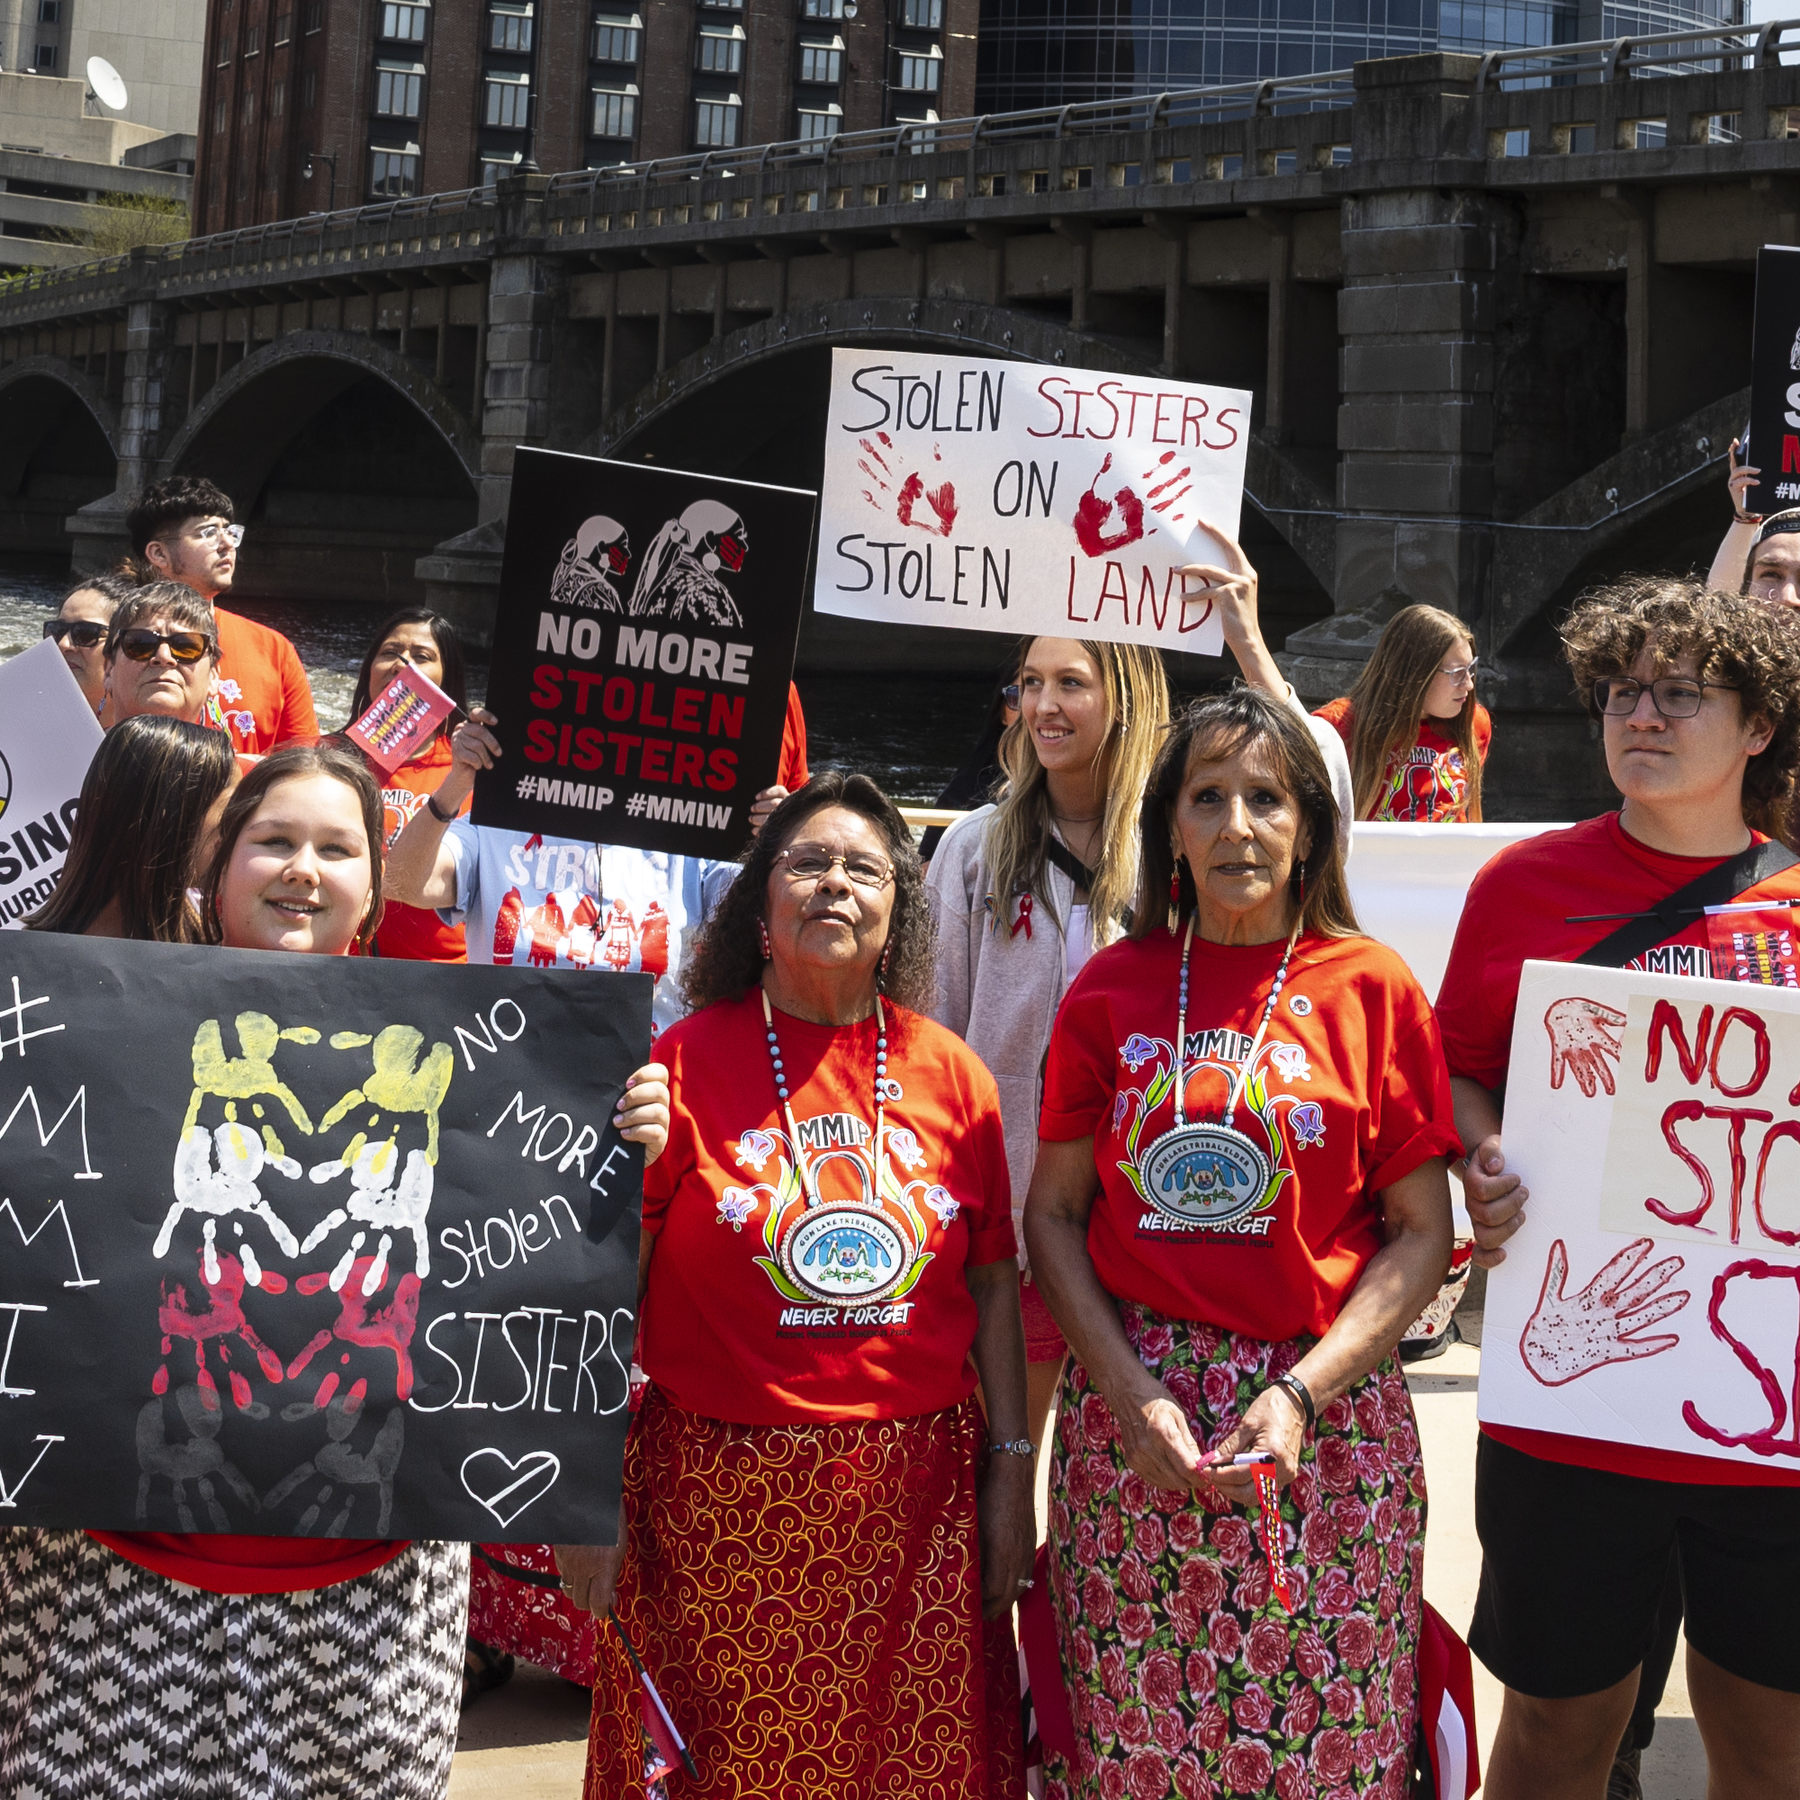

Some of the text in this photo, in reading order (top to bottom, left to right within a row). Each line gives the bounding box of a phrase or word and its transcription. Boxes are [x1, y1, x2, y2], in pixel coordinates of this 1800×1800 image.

[841, 364, 1241, 450] STOLEN SISTERS
[993, 459, 1059, 518] ON
[835, 533, 1214, 634] STOLEN LAND
[536, 611, 754, 685] NO MORE
[529, 664, 747, 739] STOLEN
[523, 719, 739, 792] SISTERS
[516, 774, 733, 831] #MMIP #MMIW
[1646, 945, 1713, 979] MMI
[454, 998, 527, 1072] NO
[1183, 1028, 1255, 1062] MMIP
[1644, 998, 1771, 1098] NO
[487, 1091, 630, 1197] MORE
[798, 1113, 872, 1149] MMIP
[1155, 1141, 1250, 1174] GUN LAKE TRIBAL ELDER
[800, 1218, 895, 1249] GUN LAKE TRIBAL ELDER
[779, 1302, 916, 1327] NEVER FORGET
[408, 1306, 634, 1416] SISTERS
